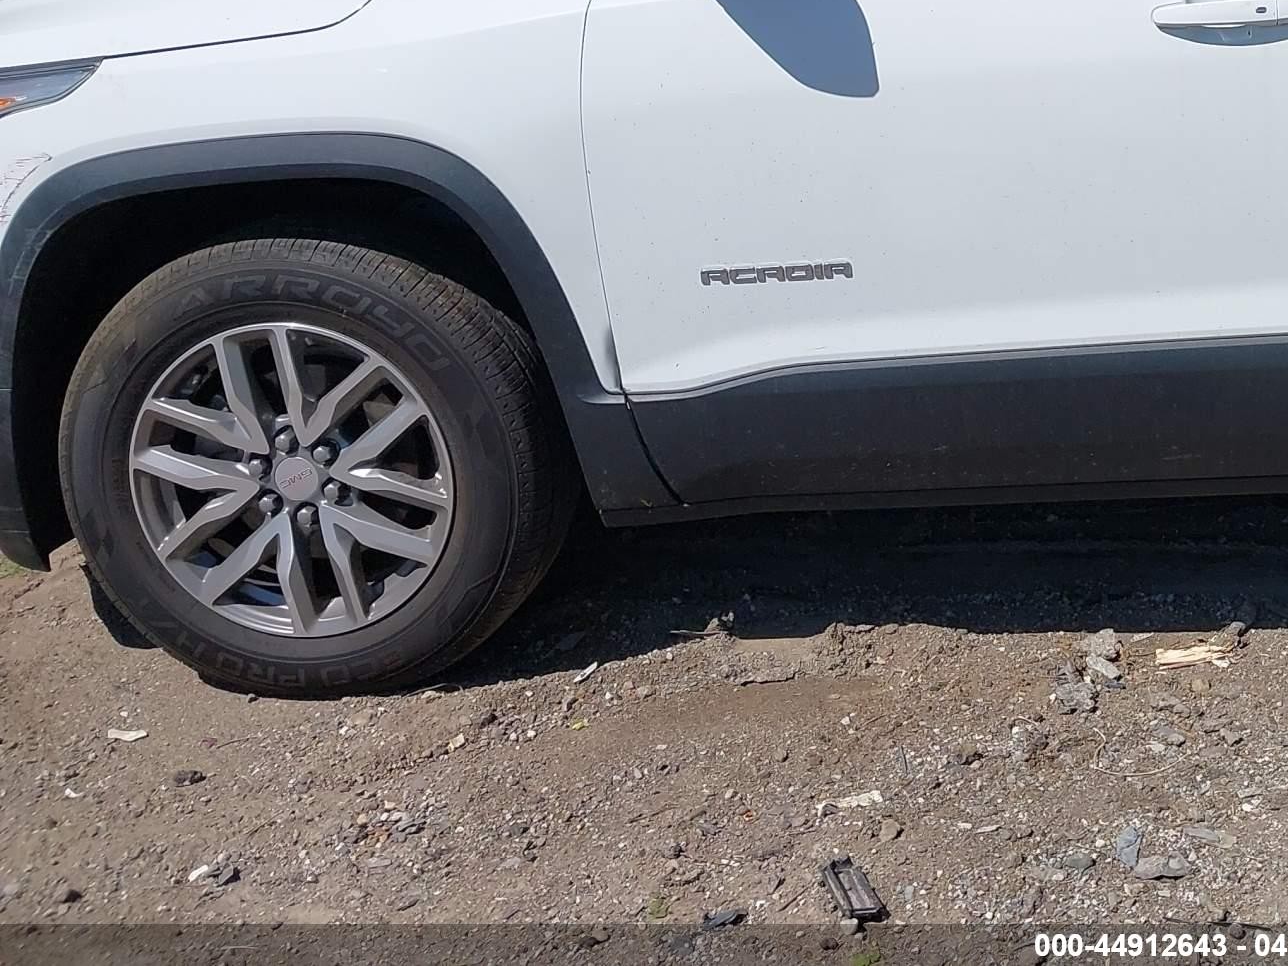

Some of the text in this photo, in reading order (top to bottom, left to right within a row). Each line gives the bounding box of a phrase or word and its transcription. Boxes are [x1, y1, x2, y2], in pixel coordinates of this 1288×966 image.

[700, 262, 854, 286] ACADIA
[171, 273, 450, 372] ARROYO
[279, 468, 313, 489] GMC
[215, 652, 306, 688] PRO
